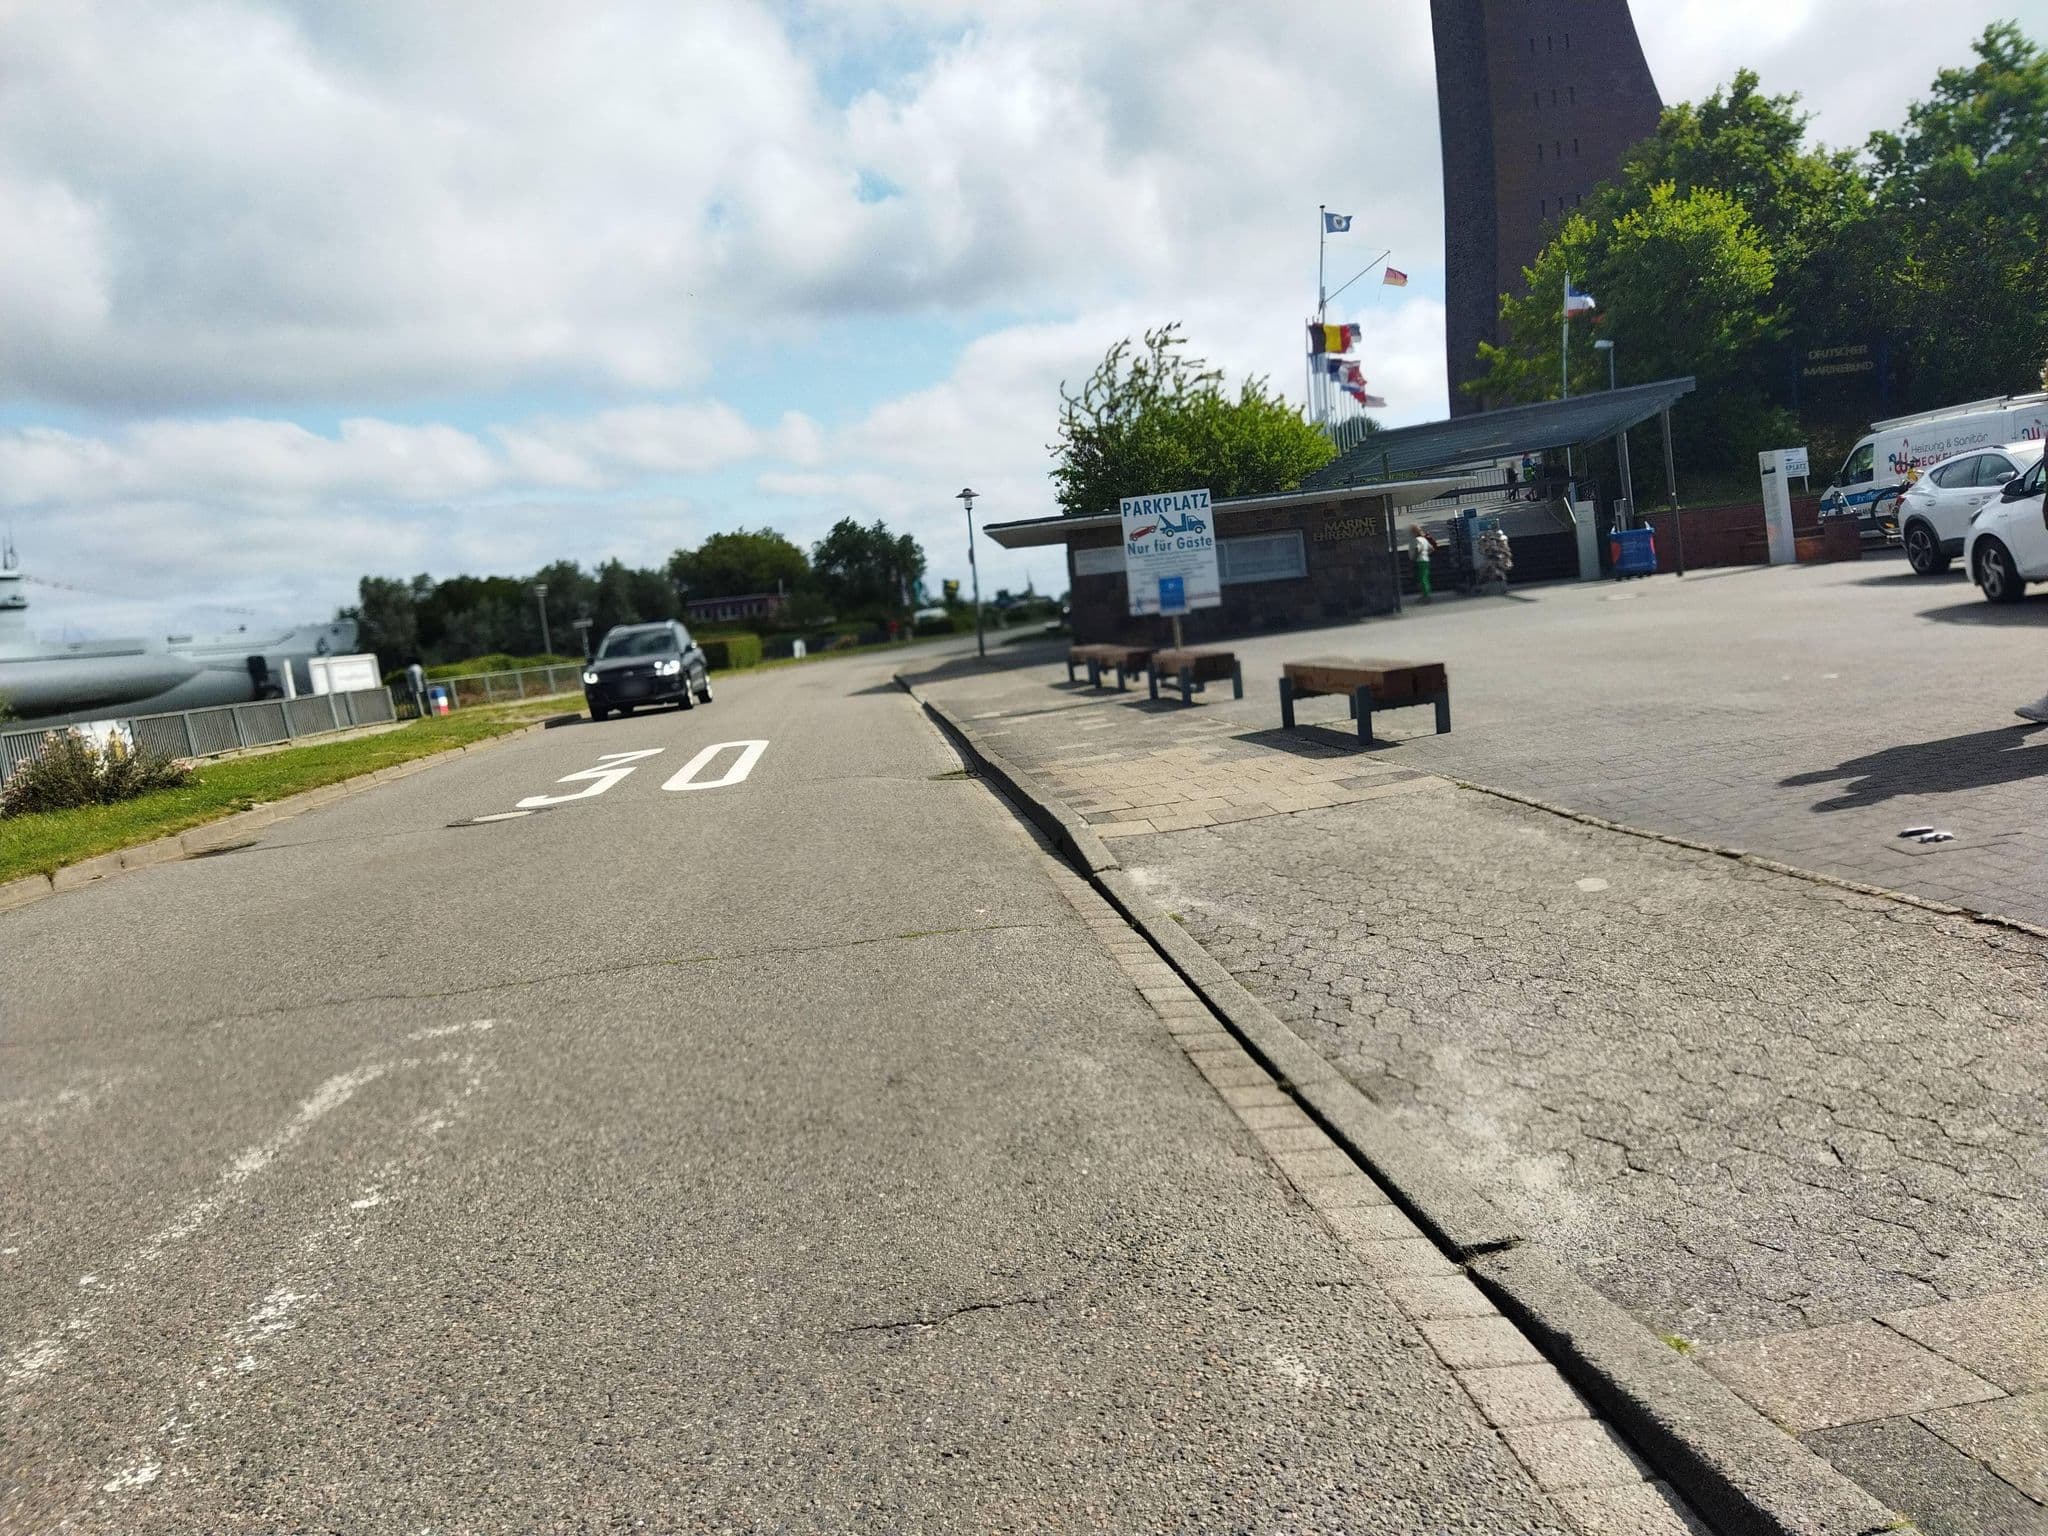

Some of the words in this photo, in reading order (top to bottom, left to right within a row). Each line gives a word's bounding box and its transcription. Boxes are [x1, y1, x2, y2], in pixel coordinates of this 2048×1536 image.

[1911, 441, 1945, 454] Heizung
[1953, 432, 1988, 447] Sanitär
[1122, 493, 1209, 517] PARKPLATZ
[1328, 517, 1377, 530] MARINE
[1127, 543, 1150, 556] Nur
[1155, 539, 1172, 552] für
[1177, 536, 1213, 550] Gäste
[515, 740, 770, 808] 30
